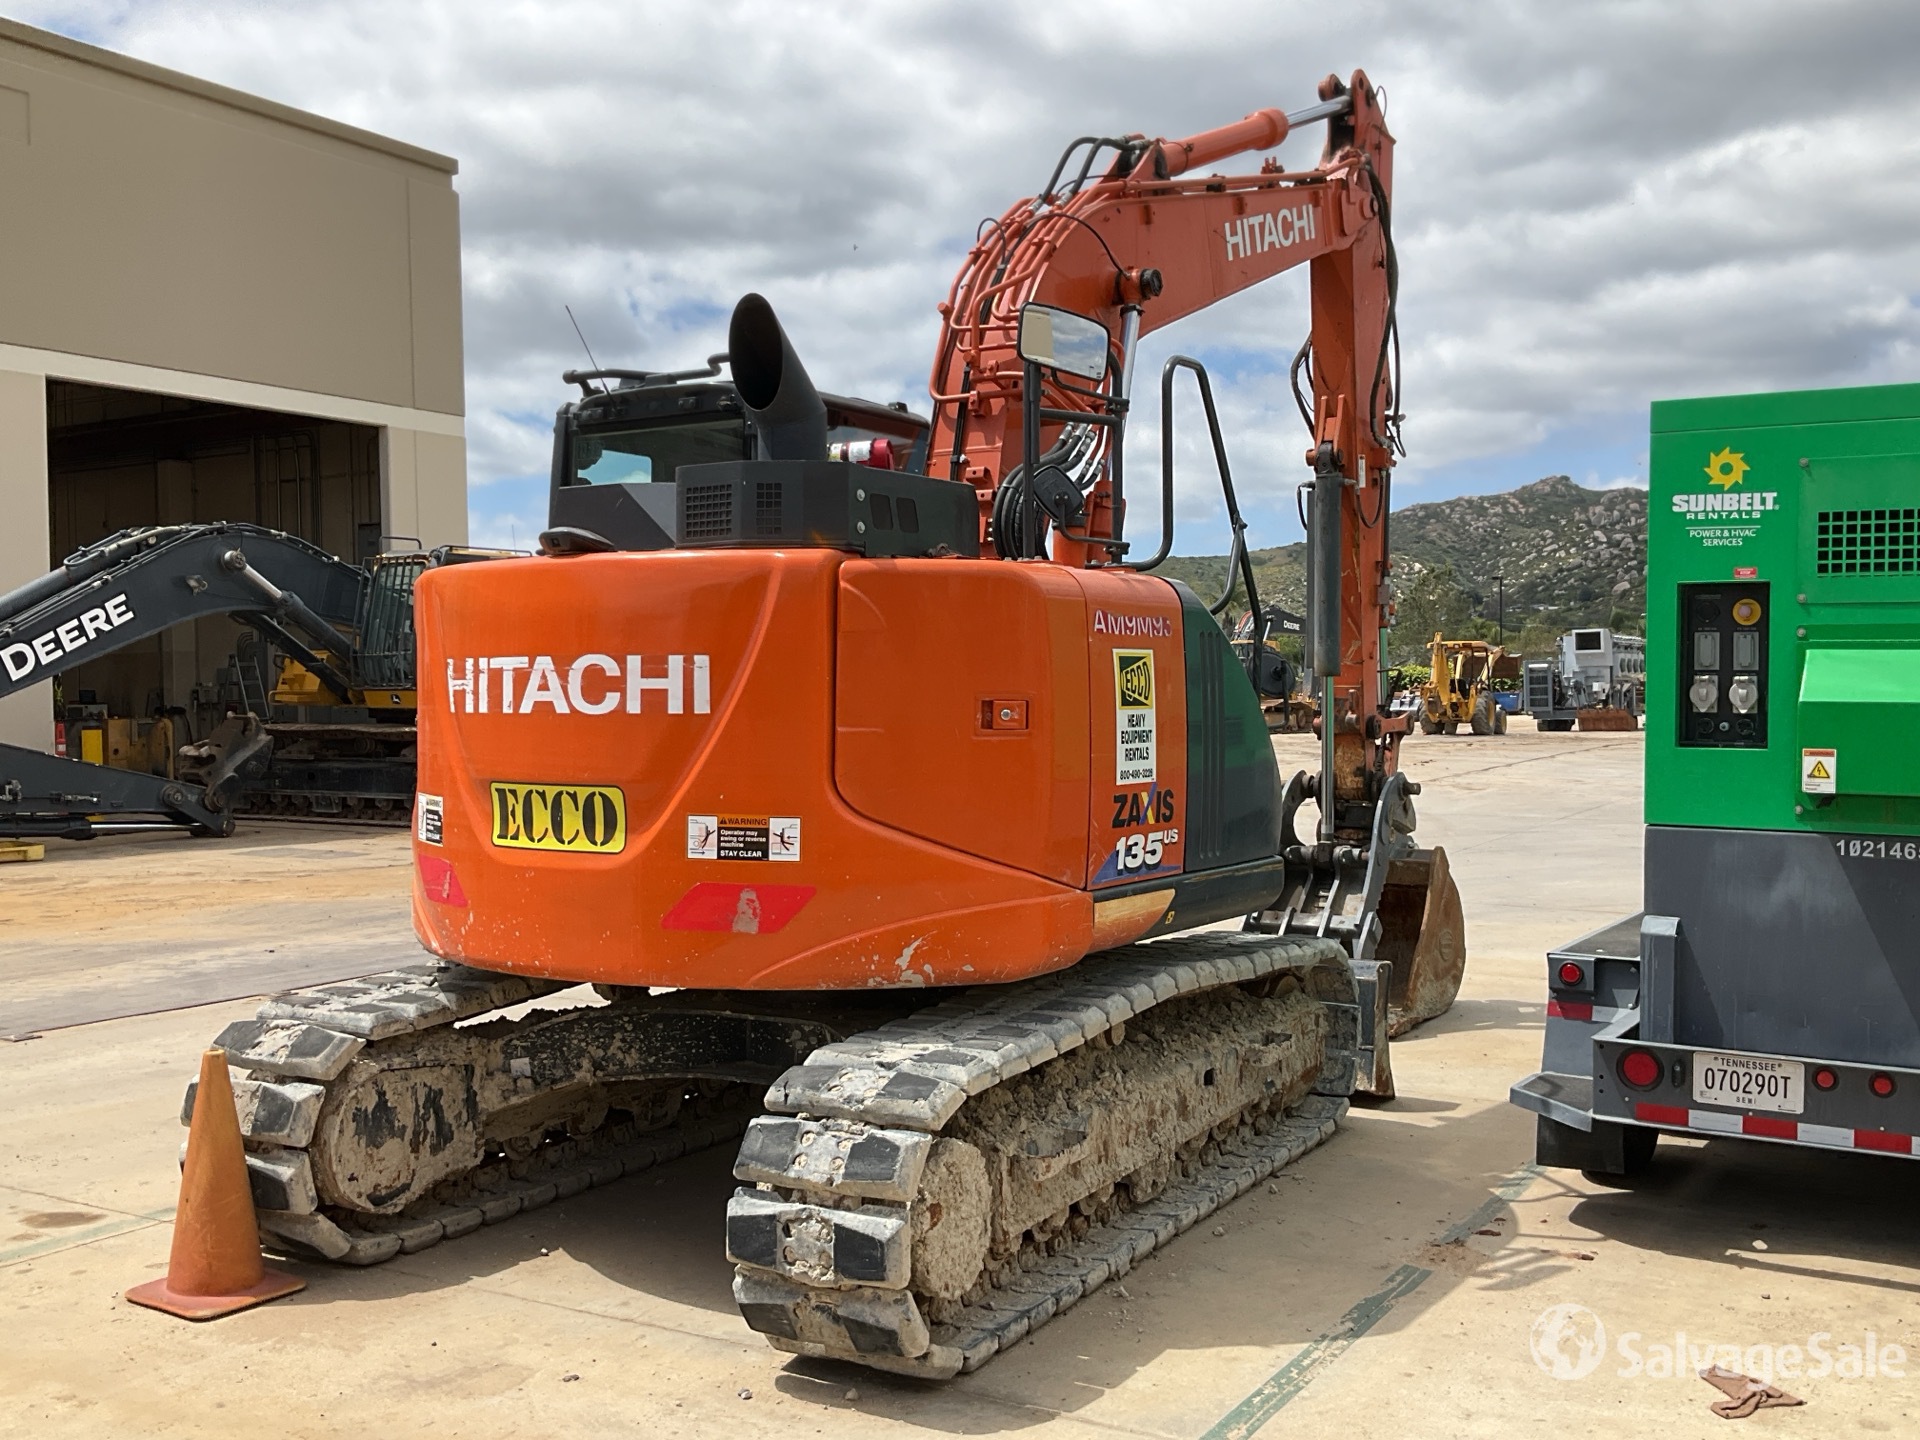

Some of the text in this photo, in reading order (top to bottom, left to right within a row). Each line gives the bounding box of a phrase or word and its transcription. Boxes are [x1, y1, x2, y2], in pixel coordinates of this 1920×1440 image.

[1224, 203, 1315, 261] HITACHI
[1672, 492, 1777, 512] SUNBELT
[1686, 511, 1761, 520] RENTALS
[1689, 529, 1721, 538] POWER
[1731, 528, 1757, 537] HVAC
[1702, 538, 1743, 546] SERVICES
[1283, 620, 1300, 631] DEERE
[0, 593, 134, 682] DEERE
[447, 653, 711, 715] HITACHI
[1124, 661, 1151, 701] ECCO
[1127, 713, 1146, 728] HEAVY
[1121, 729, 1153, 744] EQUIPMENT
[1125, 746, 1149, 761] RENTALS
[1112, 782, 1174, 828] ZAXIS
[494, 787, 618, 847] ECCO
[727, 817, 768, 826] WARNING
[720, 829, 745, 837] Operator
[720, 849, 762, 858] STAY CLEAR
[1116, 828, 1179, 874] 135 US
[1836, 838, 1920, 859] 102146
[1720, 1057, 1777, 1072] TENNESSEE
[1704, 1067, 1791, 1099] 070290T
[1736, 1096, 1757, 1105] SEMI
